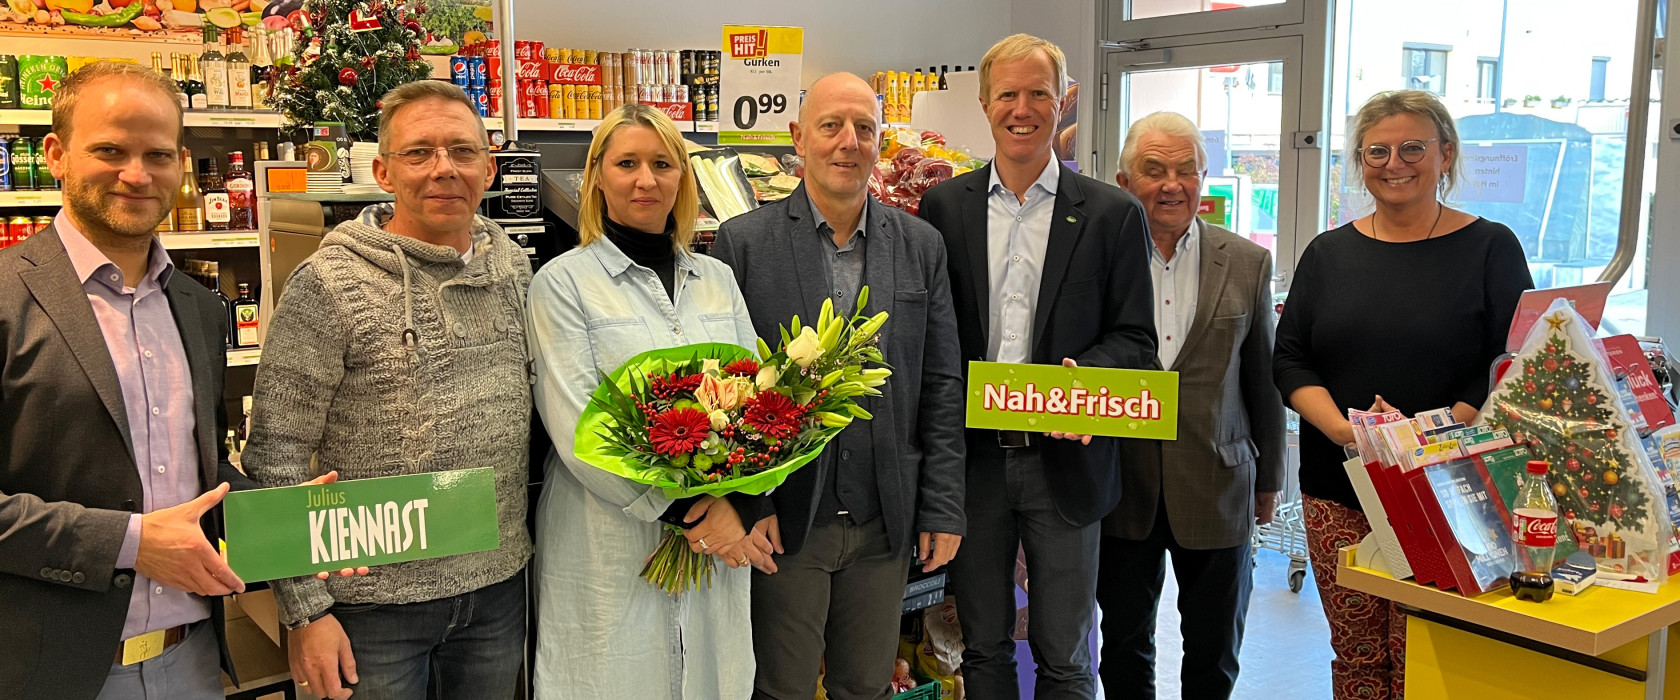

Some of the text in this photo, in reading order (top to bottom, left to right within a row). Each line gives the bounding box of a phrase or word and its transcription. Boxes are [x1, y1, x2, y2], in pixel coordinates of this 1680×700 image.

[734, 34, 756, 44] PREIS
[743, 57, 781, 67] Gurken
[20, 63, 46, 90] HEINEKEN
[20, 93, 53, 106] Heine
[11, 152, 35, 166] Gösser
[1627, 370, 1653, 390] lück
[983, 383, 1162, 420] Nah&Frisch
[306, 488, 346, 508] Julius
[308, 498, 429, 564] KIENNAST
[909, 578, 941, 593] BROCCOLI
